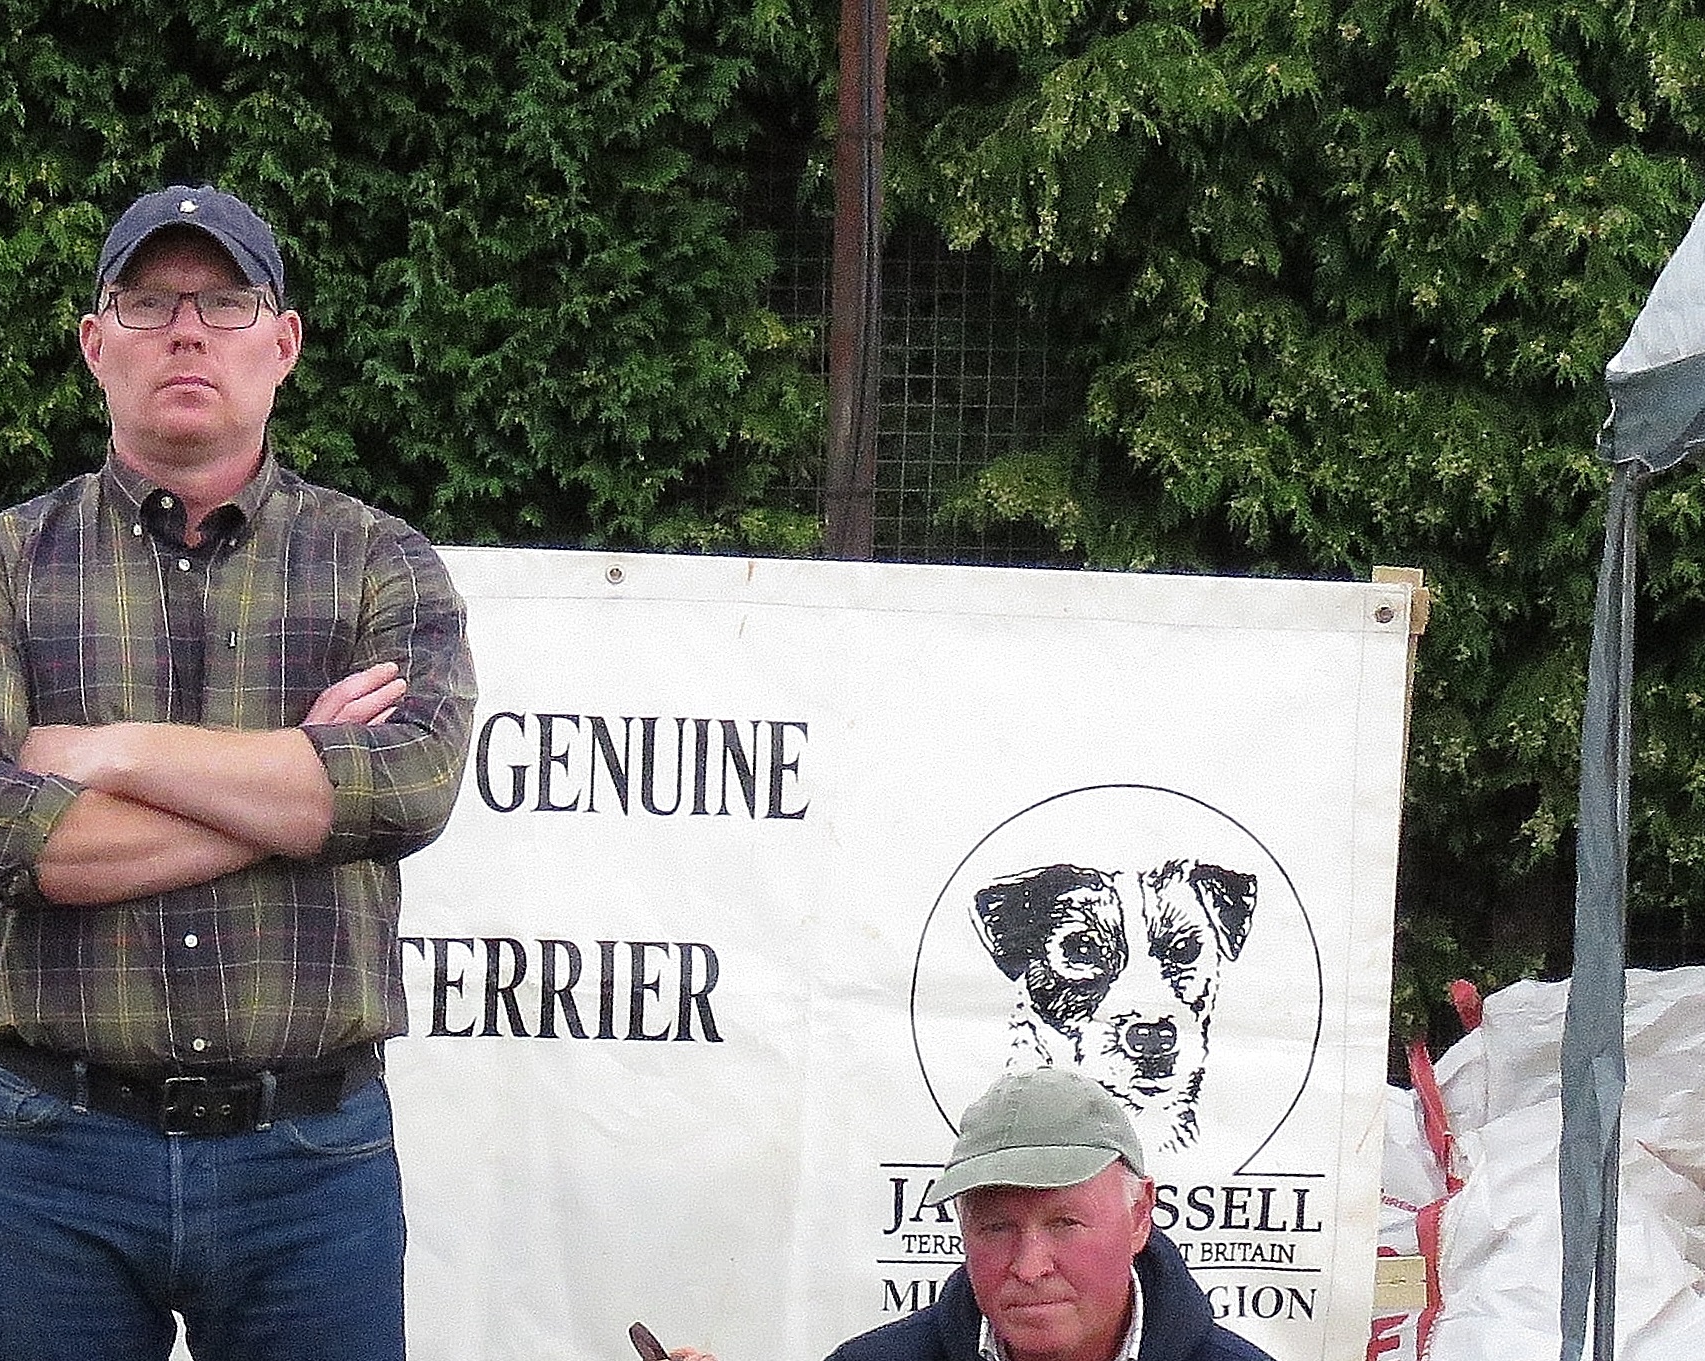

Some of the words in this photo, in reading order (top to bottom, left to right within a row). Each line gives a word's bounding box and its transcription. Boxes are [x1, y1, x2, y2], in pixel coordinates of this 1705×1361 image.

[475, 712, 811, 820] GENUINE
[883, 1178, 954, 1234] JA
[1151, 1184, 1322, 1232] SSELL
[901, 1234, 964, 1255] TERR
[1200, 1242, 1295, 1263] BRITAIN
[1207, 1285, 1317, 1321] GION
